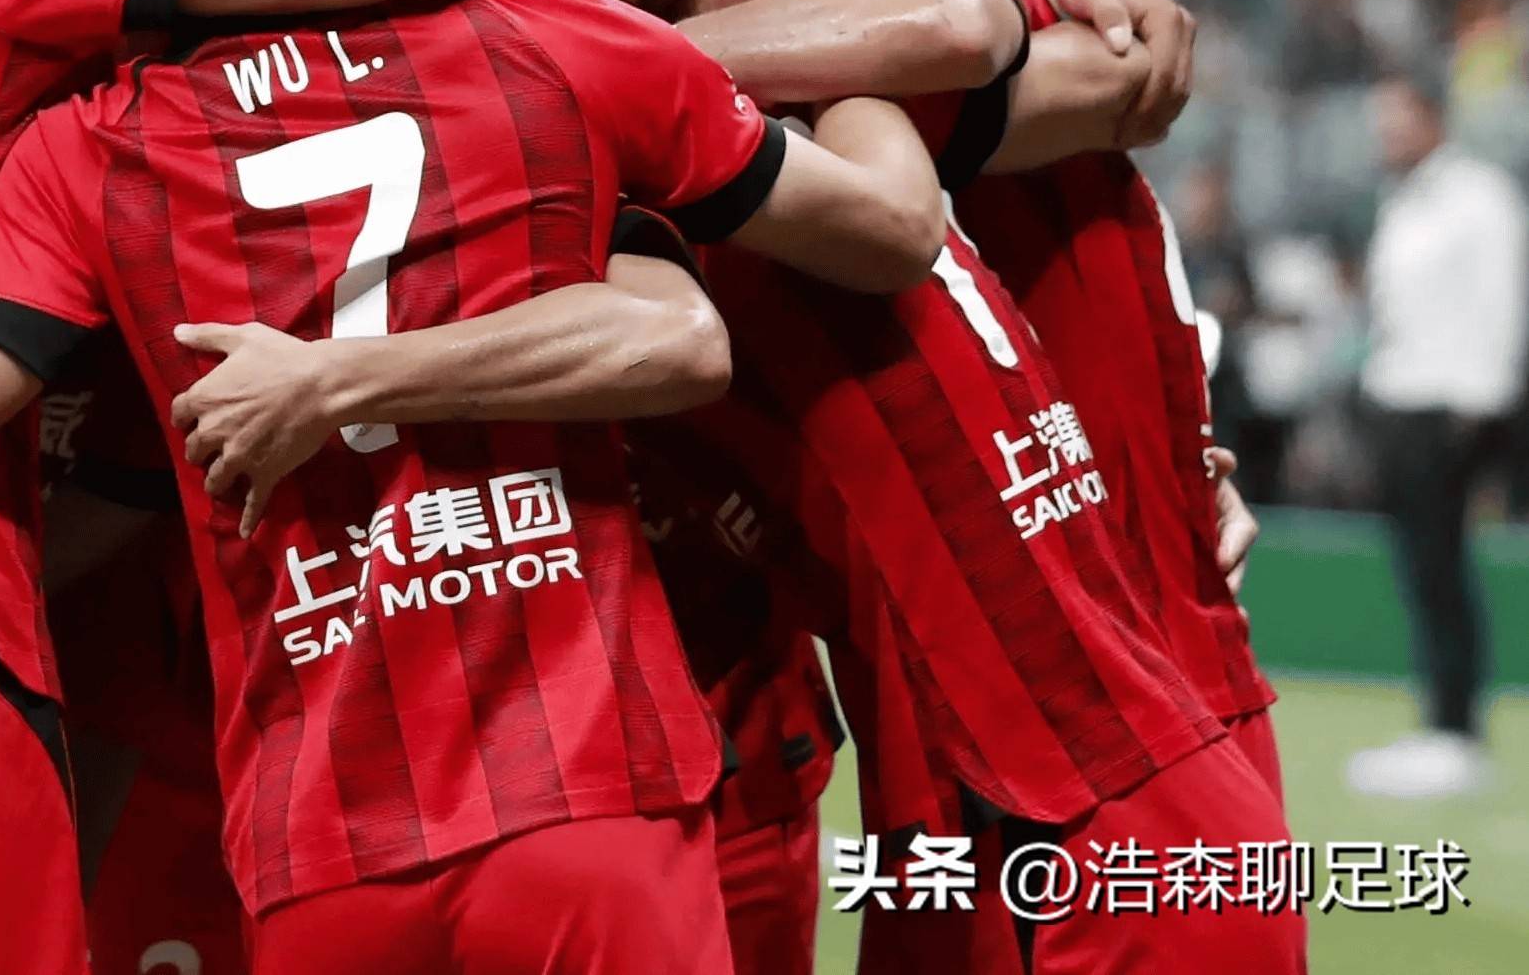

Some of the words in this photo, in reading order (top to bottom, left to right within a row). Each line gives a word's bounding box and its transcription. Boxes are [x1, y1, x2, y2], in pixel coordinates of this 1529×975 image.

[223, 35, 309, 113] WU
[327, 31, 383, 82] L.
[236, 112, 425, 453] 7
[993, 401, 1093, 501] 上汽集
[274, 468, 572, 623] 上汽集团
[1012, 483, 1082, 539] SAIC
[380, 547, 583, 617] MOTOR
